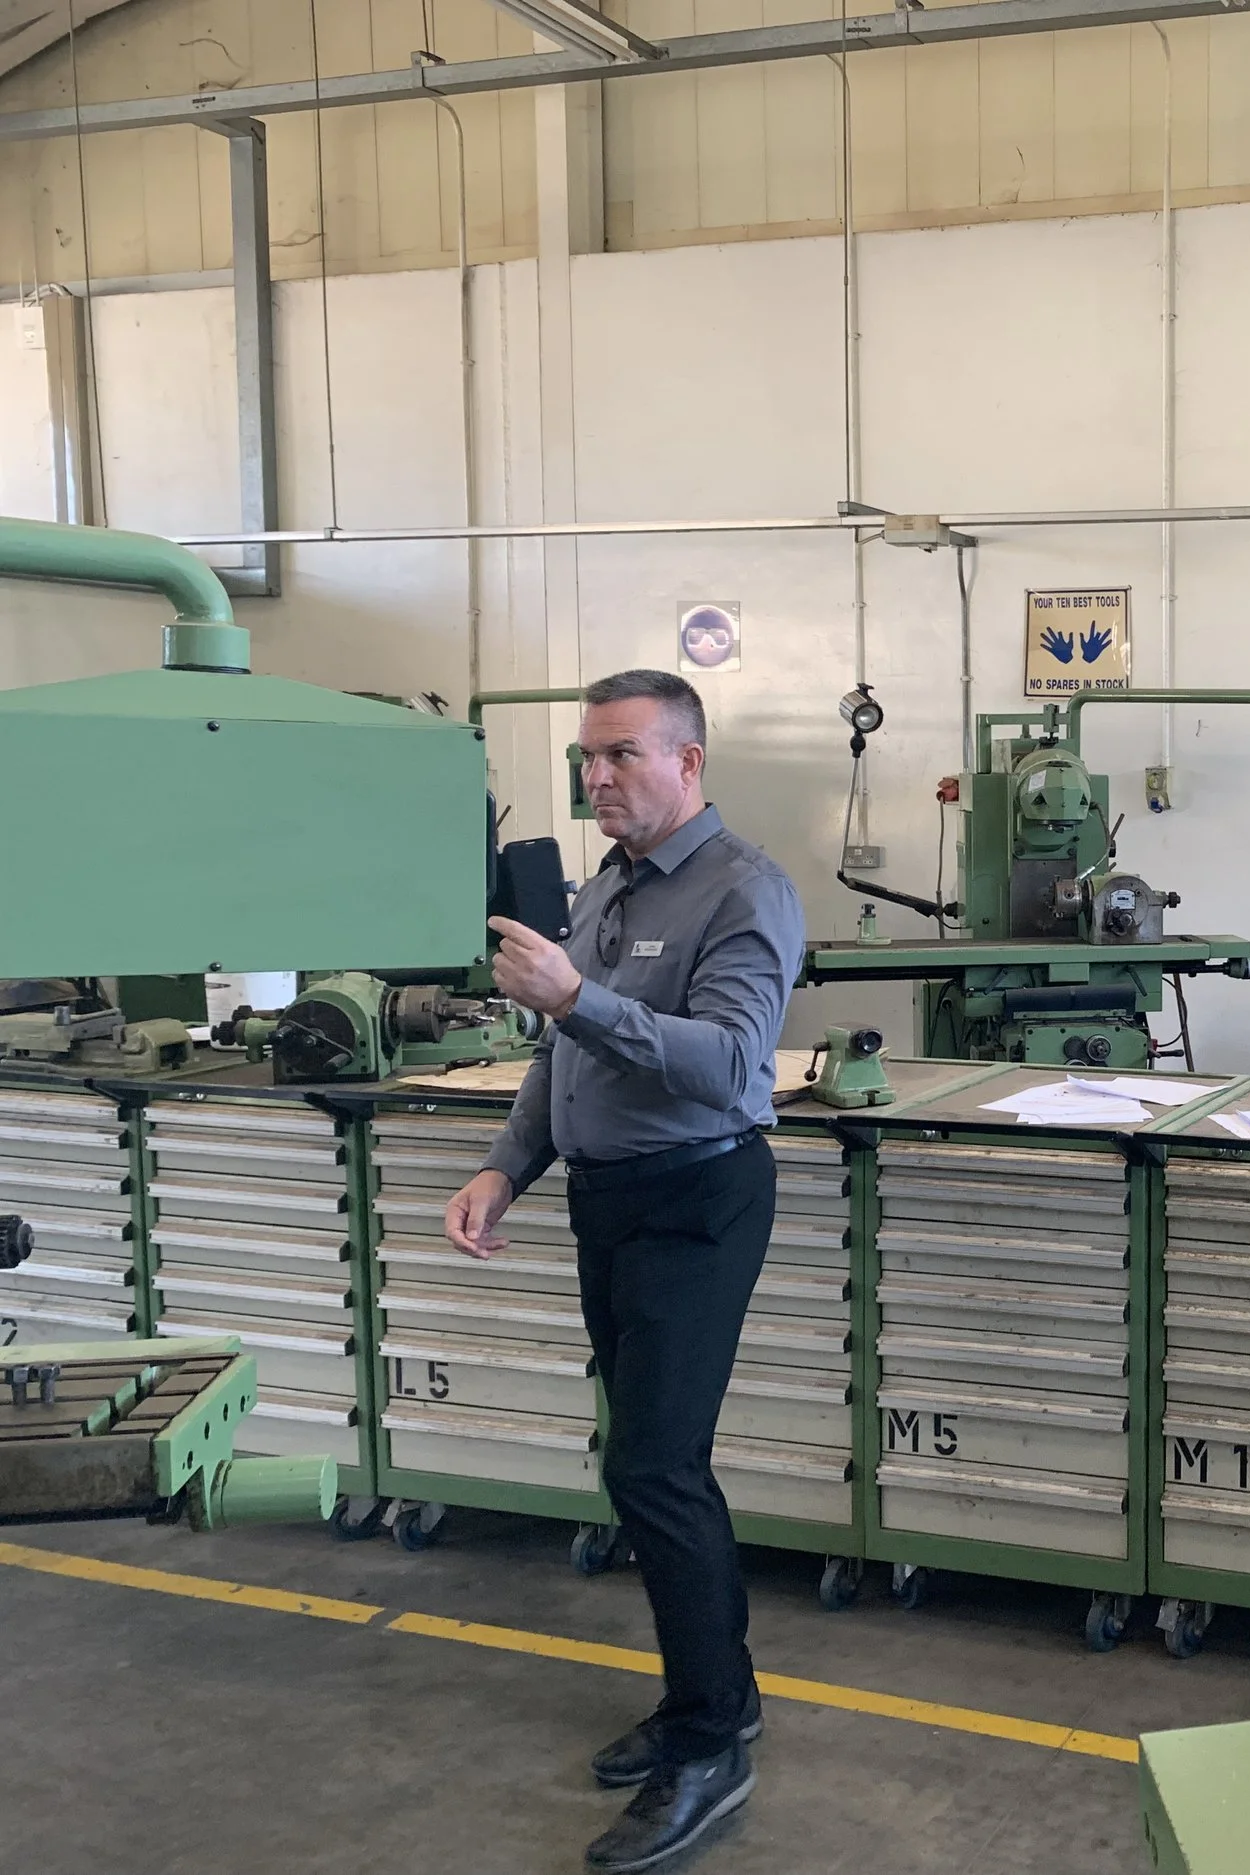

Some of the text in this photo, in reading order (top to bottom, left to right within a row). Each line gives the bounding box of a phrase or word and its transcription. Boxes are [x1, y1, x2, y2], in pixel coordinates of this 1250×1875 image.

[1034, 596, 1120, 609] YOUR TEN BEST TOOLS
[1030, 679, 1124, 690] NO SPARES IN STOCK
[396, 1358, 449, 1399] L 5
[889, 1409, 957, 1455] M 5
[1175, 1437, 1248, 1488] M 1
